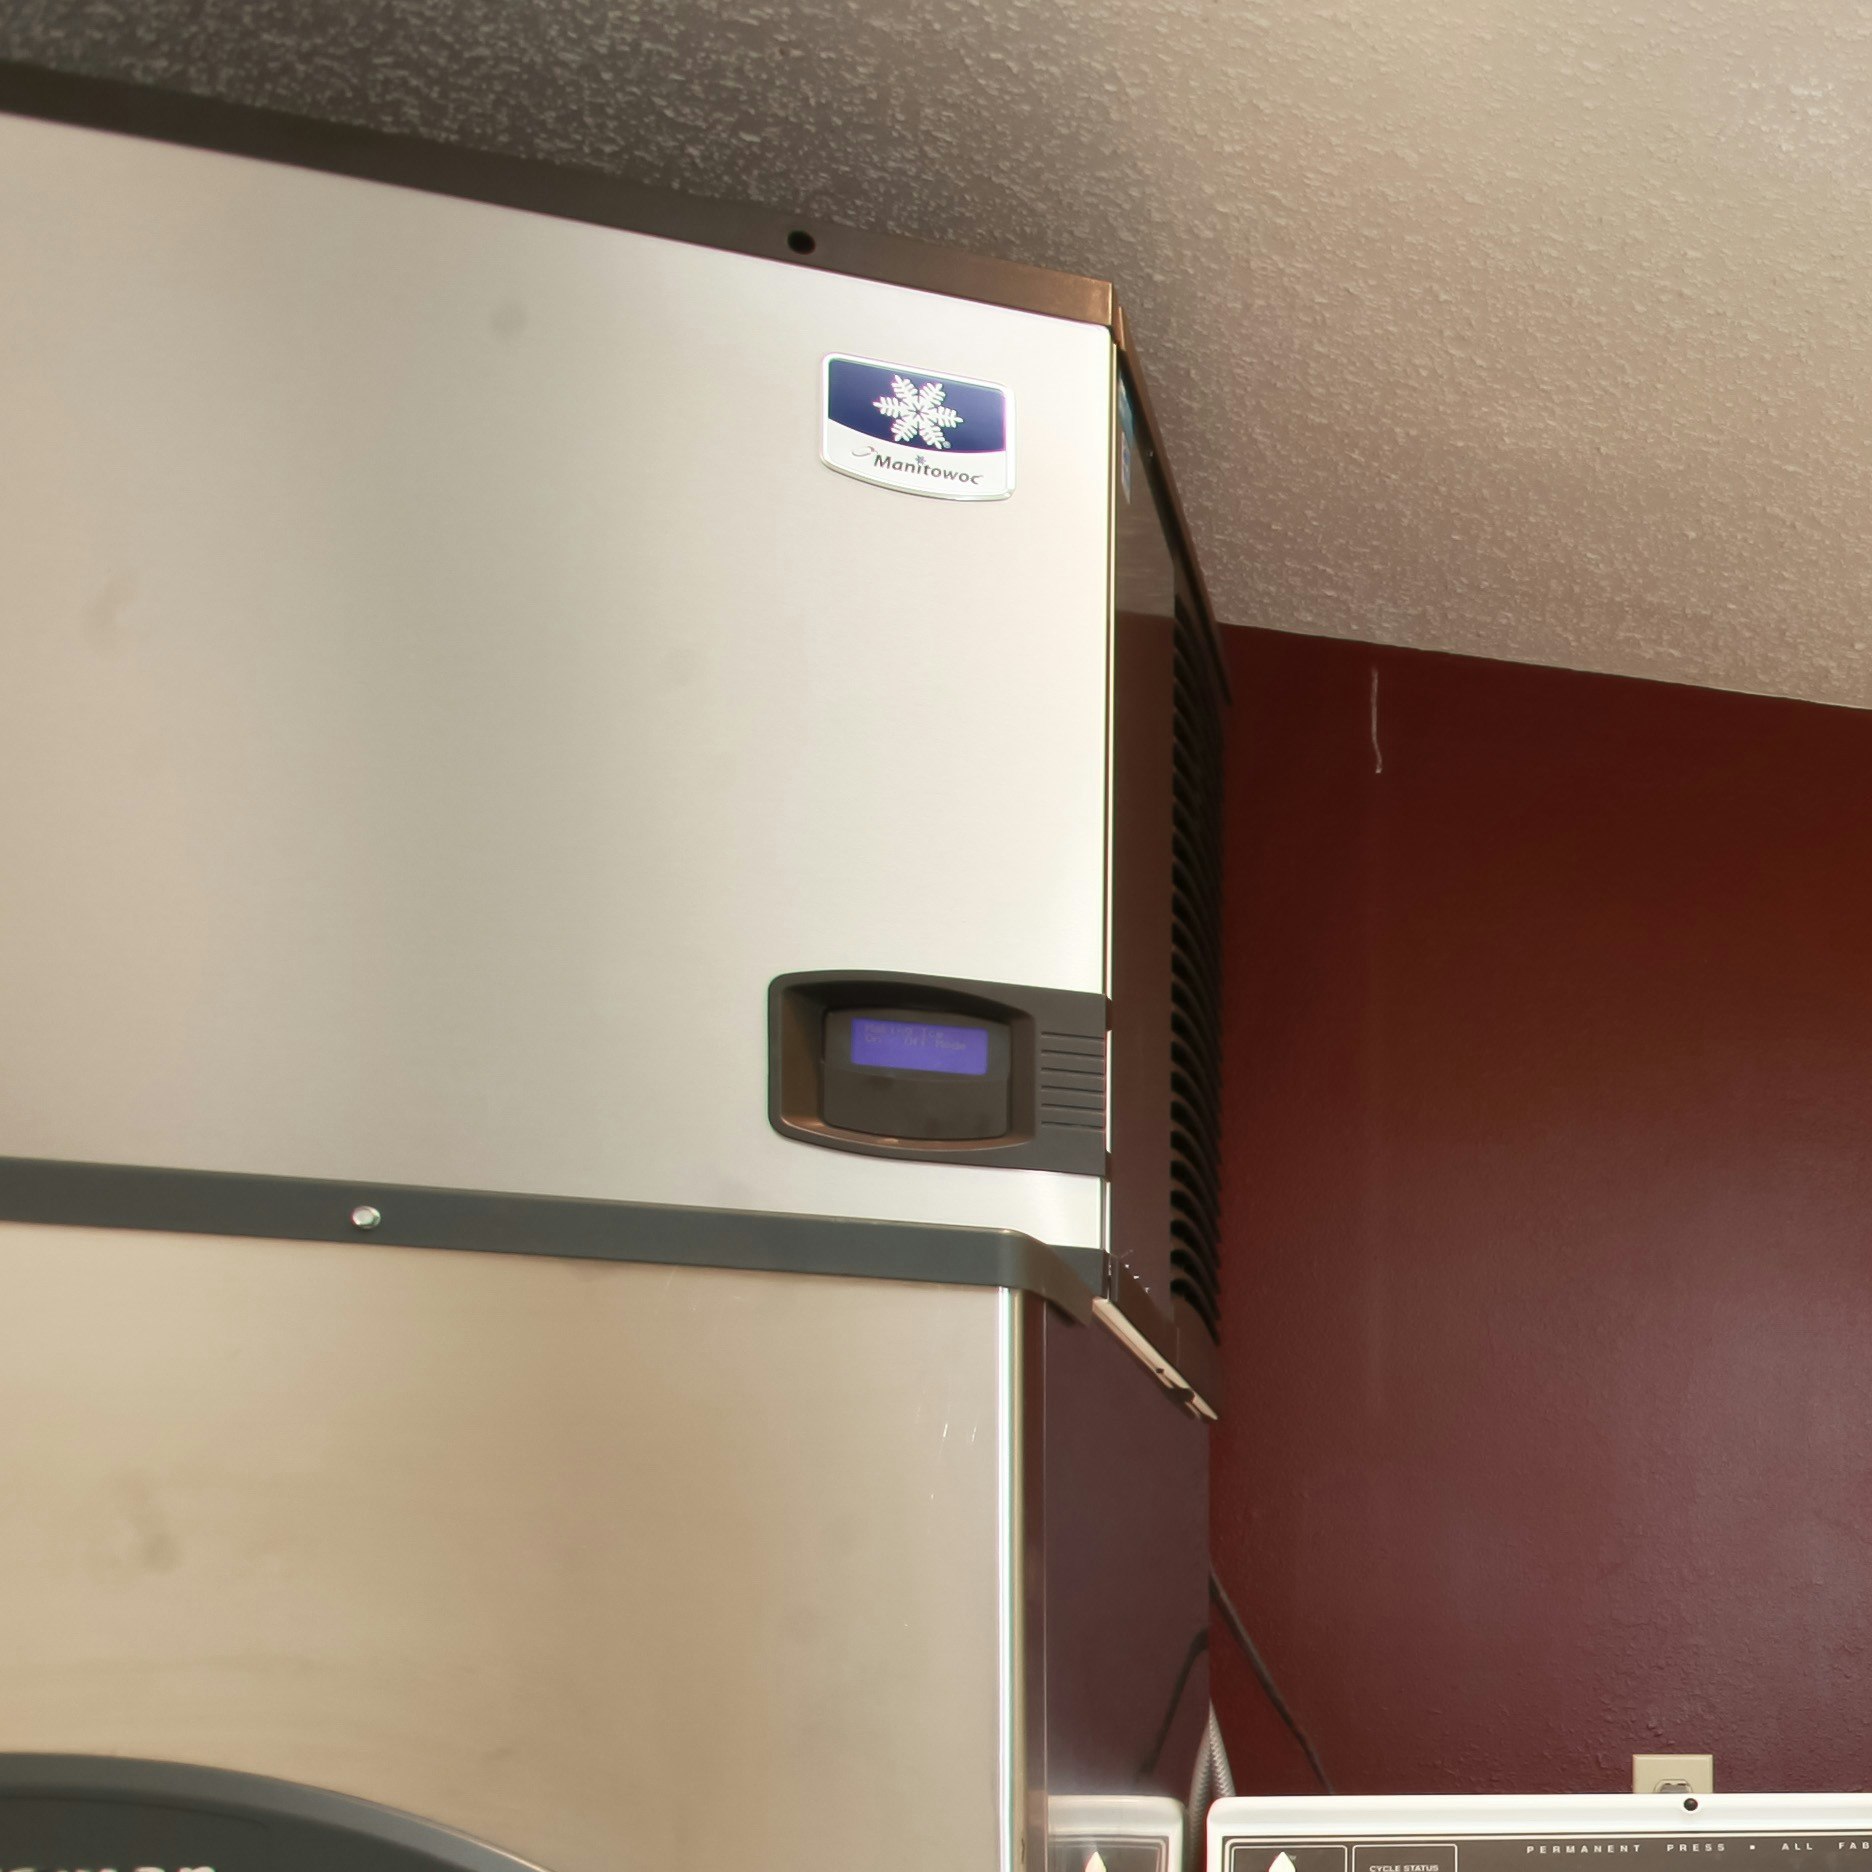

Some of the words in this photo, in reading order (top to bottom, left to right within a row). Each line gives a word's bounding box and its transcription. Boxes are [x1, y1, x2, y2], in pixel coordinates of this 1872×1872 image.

[873, 454, 984, 485] Manitowoc
[1527, 1844, 1641, 1855] PERMANENT
[1667, 1843, 1726, 1853] PRESS
[1781, 1842, 1814, 1851] ALL
[1369, 1865, 1400, 1872] CYCLE
[1403, 1864, 1439, 1872] STATUS
